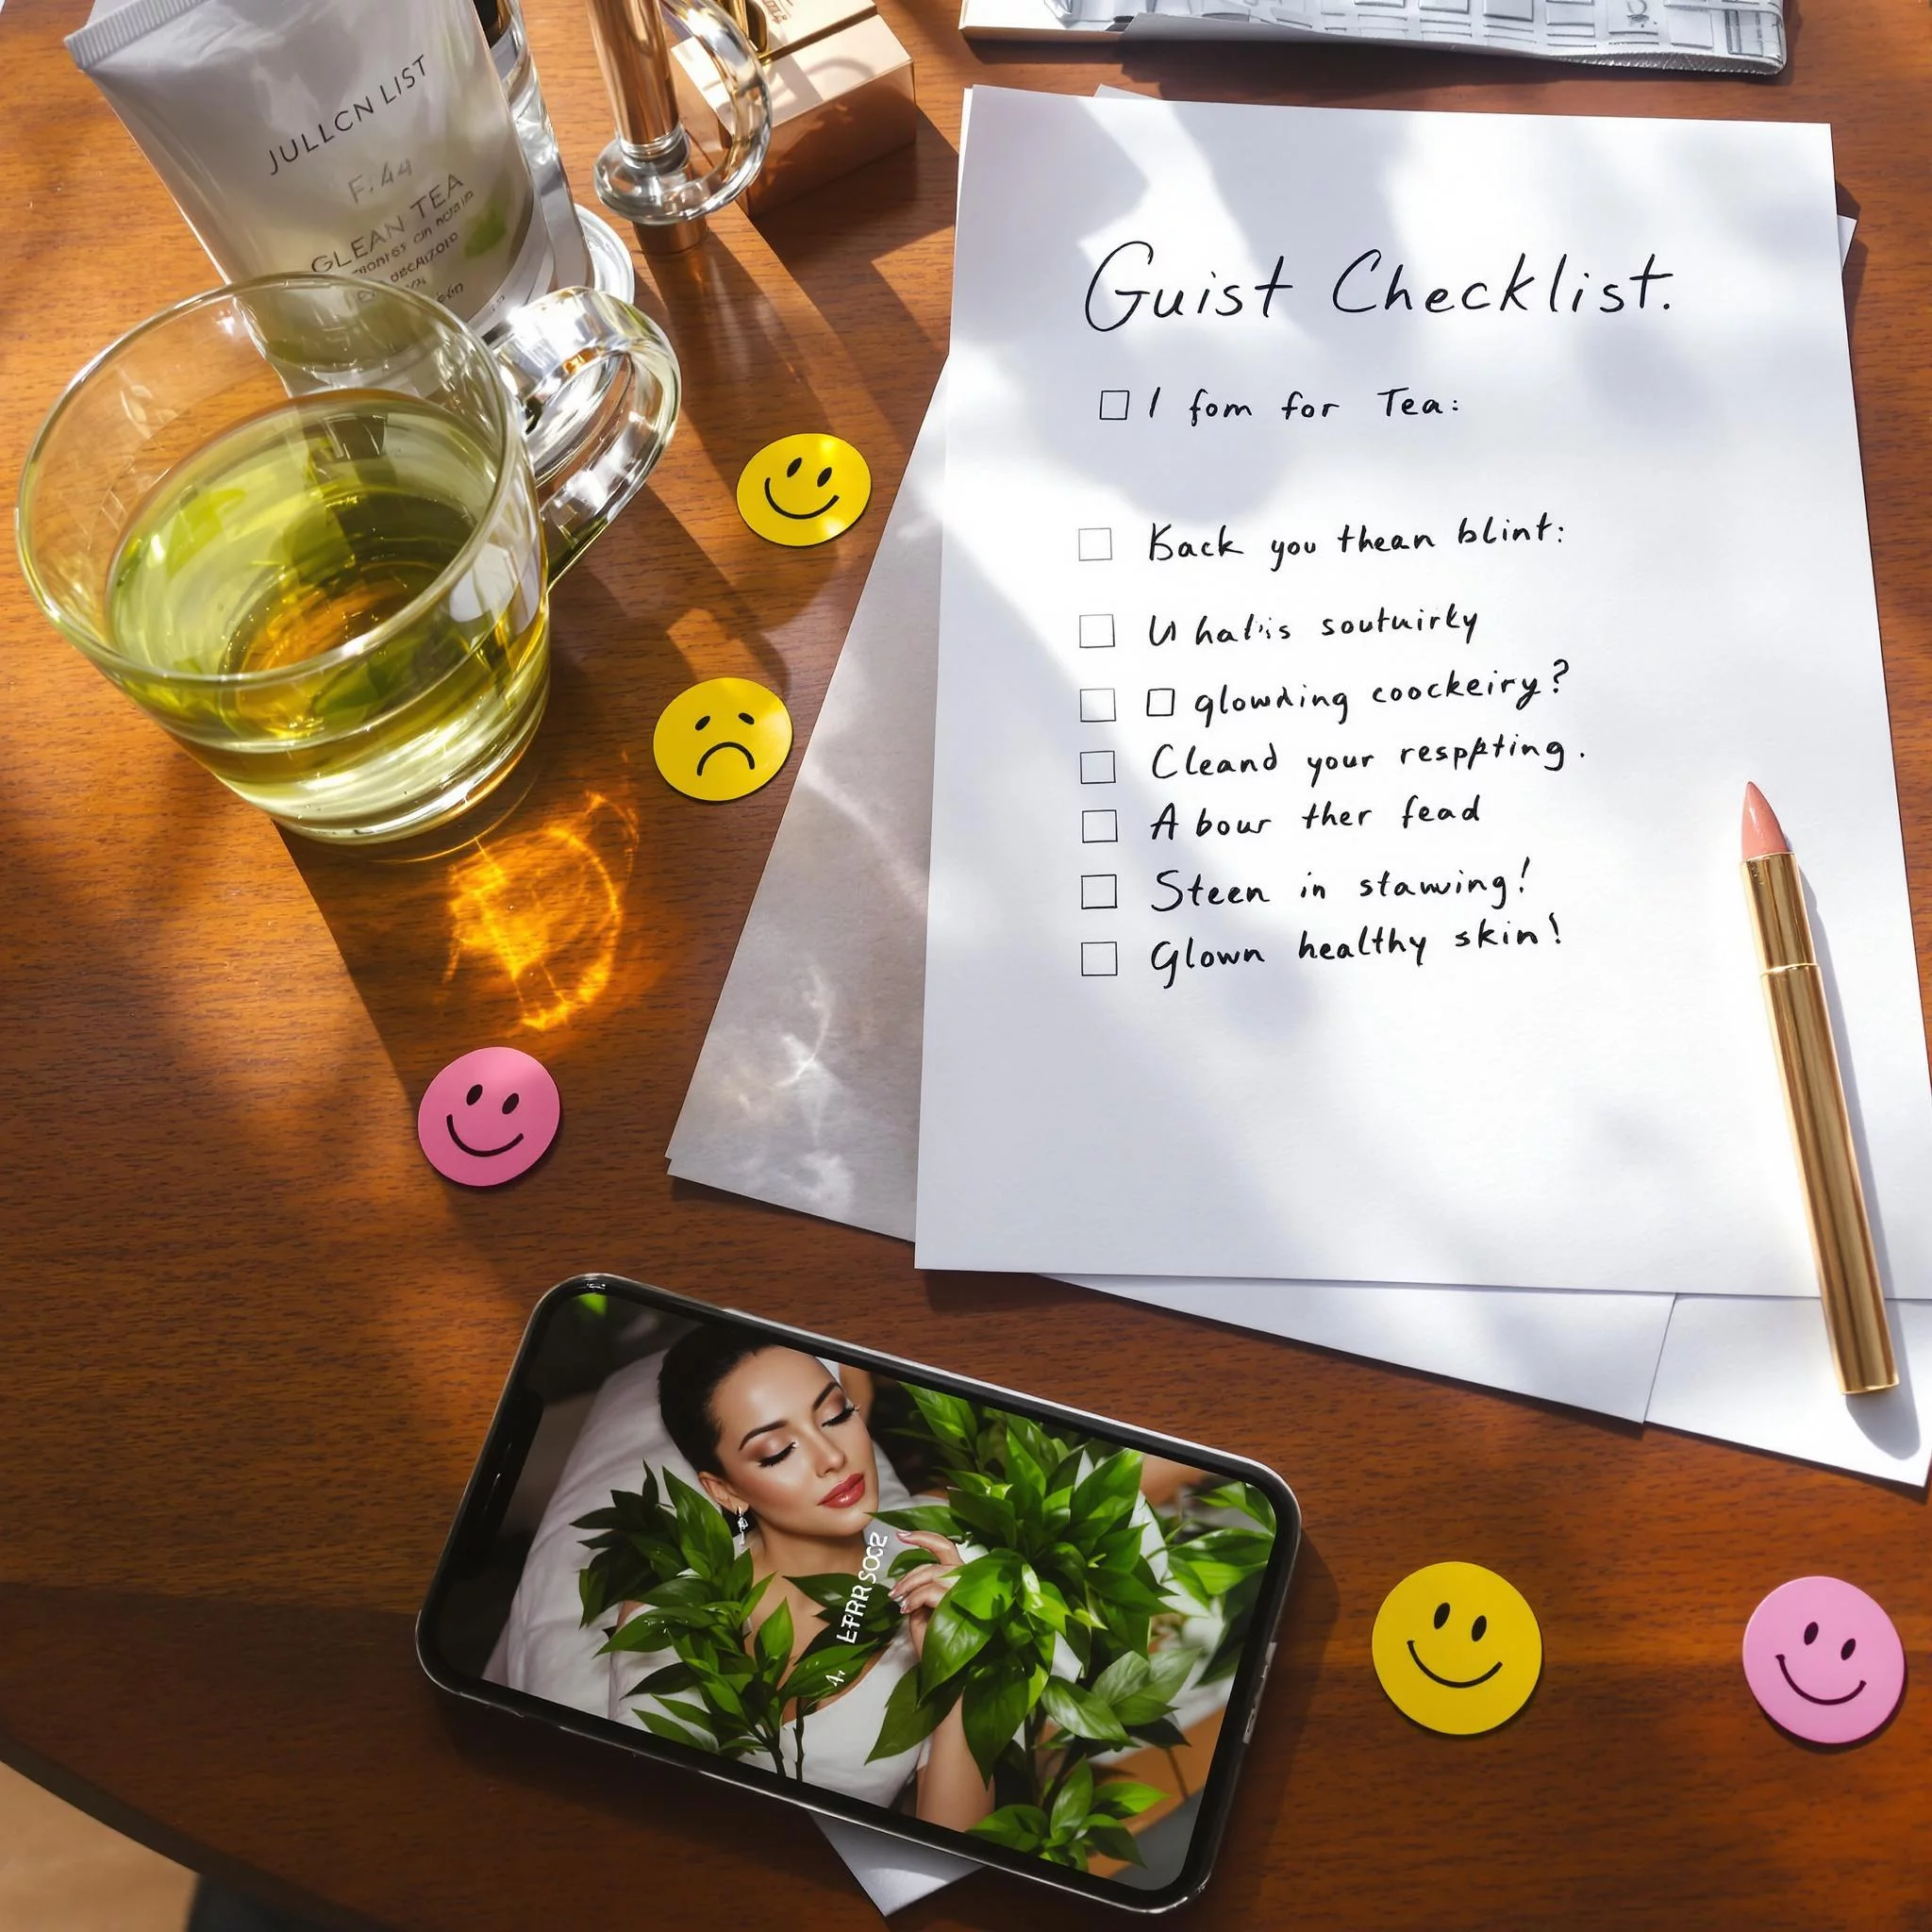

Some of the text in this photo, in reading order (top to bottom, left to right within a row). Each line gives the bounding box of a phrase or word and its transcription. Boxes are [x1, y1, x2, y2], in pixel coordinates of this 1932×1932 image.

[379, 54, 427, 105] LIST
[409, 173, 464, 220] TEA
[1084, 241, 1674, 332] Guist Checklist.
[1281, 391, 1341, 421] for
[1270, 540, 1316, 573] you
[1337, 524, 1436, 554] thean
[1151, 742, 1278, 780] Cleand
[1307, 754, 1374, 789] your
[1301, 802, 1373, 829] ther
[1402, 793, 1481, 829] fead
[1151, 869, 1271, 912] Steen
[1300, 871, 1325, 900] in
[1298, 924, 1427, 968] healthy
[1455, 911, 1560, 949] skin!
